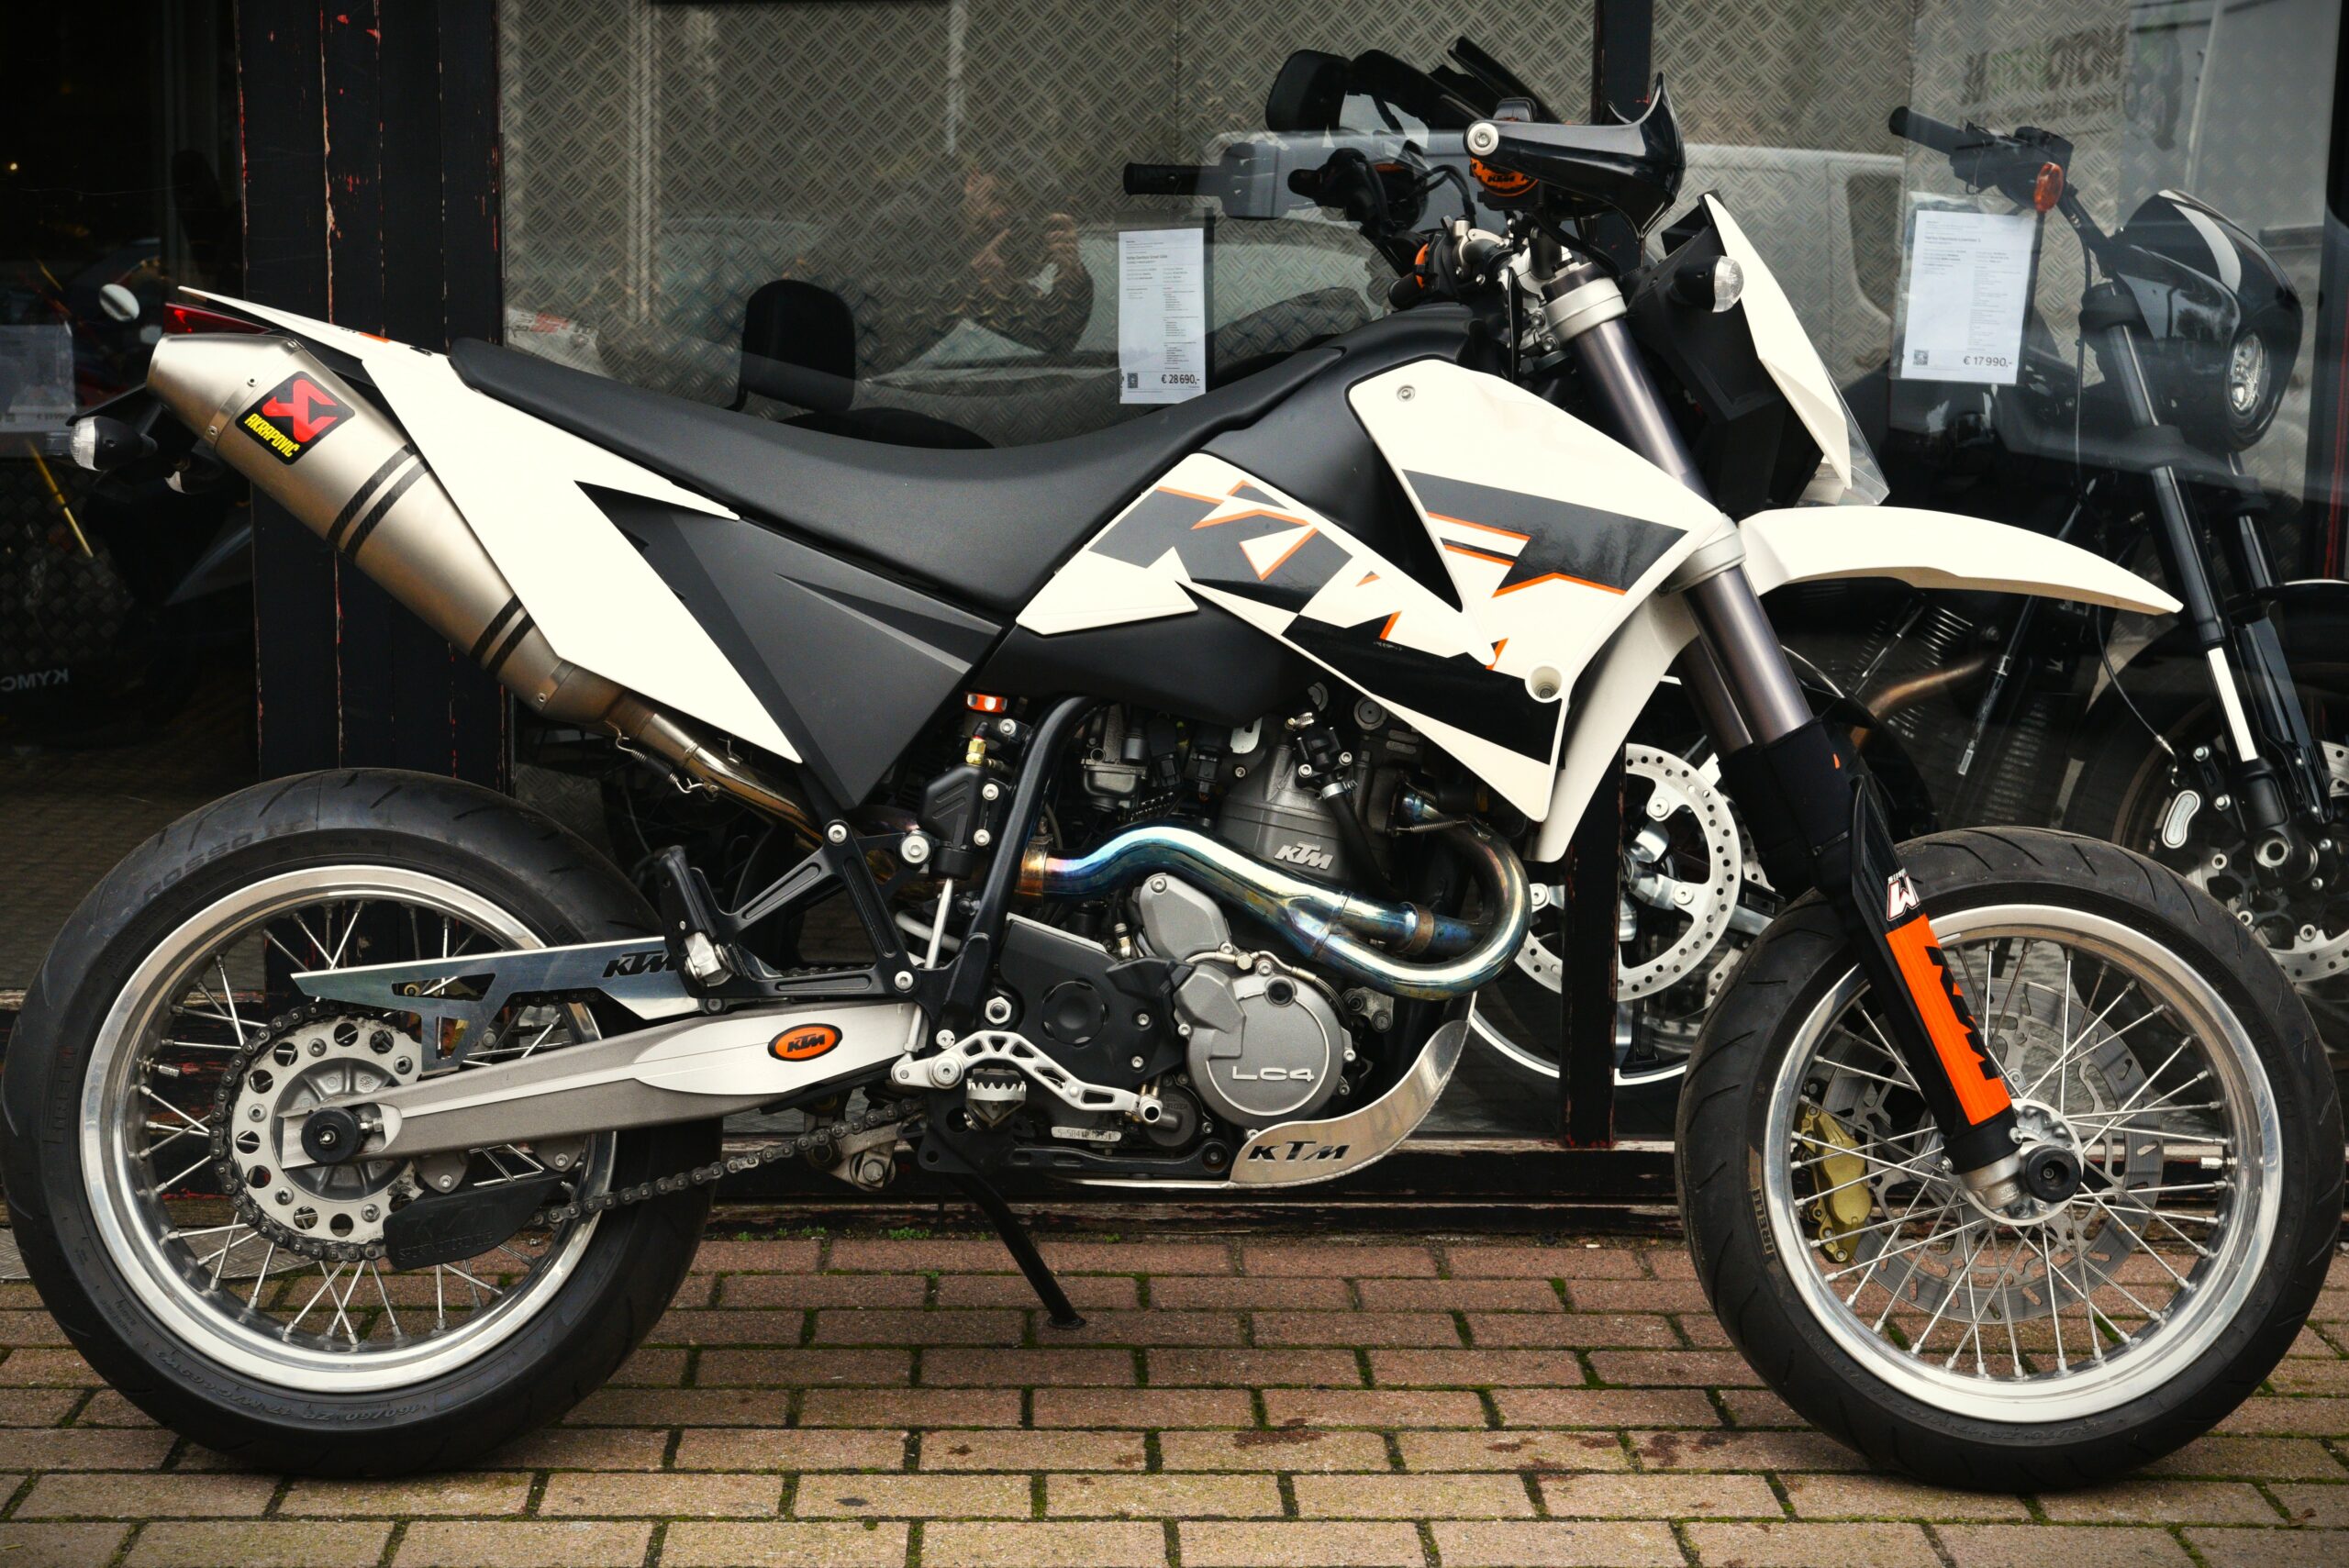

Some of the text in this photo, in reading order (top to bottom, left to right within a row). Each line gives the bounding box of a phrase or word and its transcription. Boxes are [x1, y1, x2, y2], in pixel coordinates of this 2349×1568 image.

[1964, 355, 1971, 365] €
[1161, 373, 1167, 384] €
[1275, 841, 1333, 870] KTM
[602, 950, 676, 978] KTM
[786, 1033, 826, 1052] KTM
[1231, 1065, 1314, 1083] LC4
[1248, 1140, 1350, 1162] KTM
